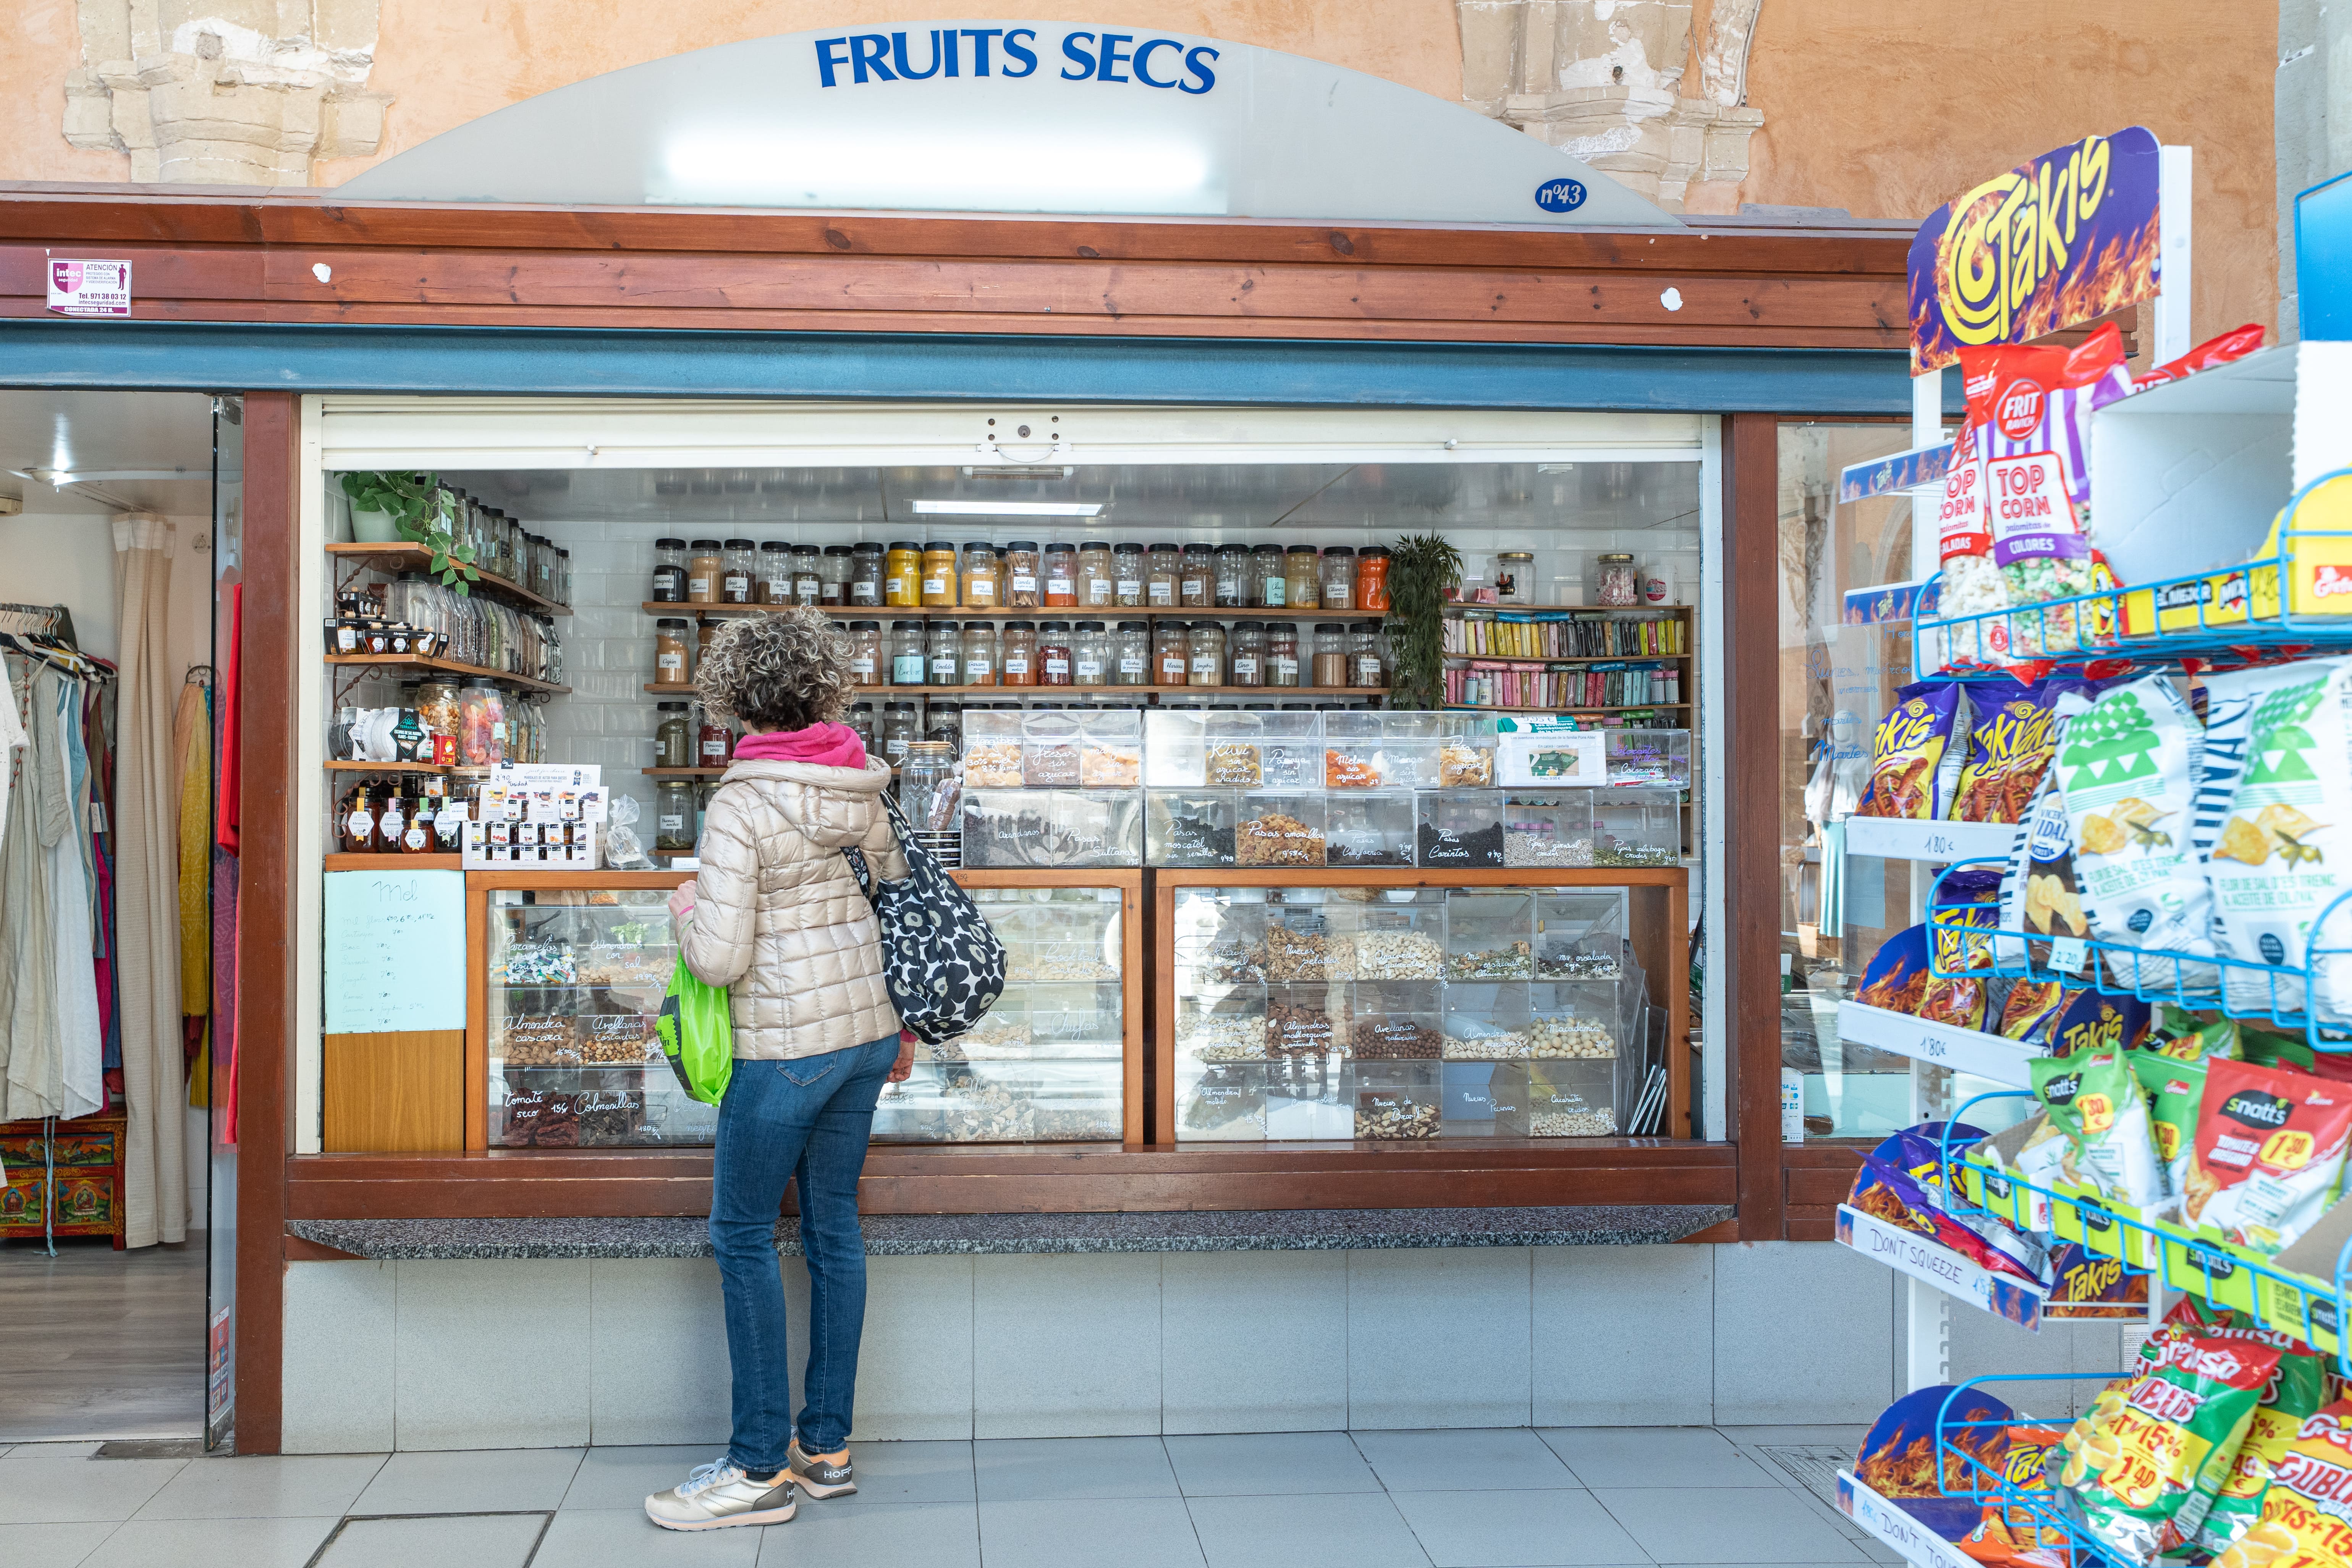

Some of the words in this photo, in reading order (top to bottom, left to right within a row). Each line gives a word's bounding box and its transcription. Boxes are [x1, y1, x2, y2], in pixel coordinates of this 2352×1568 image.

[815, 29, 1038, 88] FRUITS
[1061, 32, 1220, 94] SECS
[57, 268, 81, 277] intec
[2003, 392, 2041, 419] FRIT
[2005, 416, 2035, 431] RAVICH
[1946, 469, 1975, 498] OP
[1997, 465, 2045, 497] TOP
[1939, 496, 1975, 521] ORN
[2000, 496, 2051, 519] CORN
[2005, 522, 2042, 533] palomitas
[2009, 538, 2055, 554] COLORES
[663, 658, 676, 666] Cajún
[372, 879, 418, 902] Mel
[2043, 1079, 2078, 1100] snatts
[2228, 1097, 2286, 1125] snatts
[1870, 1228, 1907, 1263] DON'T
[1909, 1246, 1962, 1285] SQUEEZE
[824, 1465, 852, 1479] HOFF
[1881, 1513, 1919, 1548] DON'T
